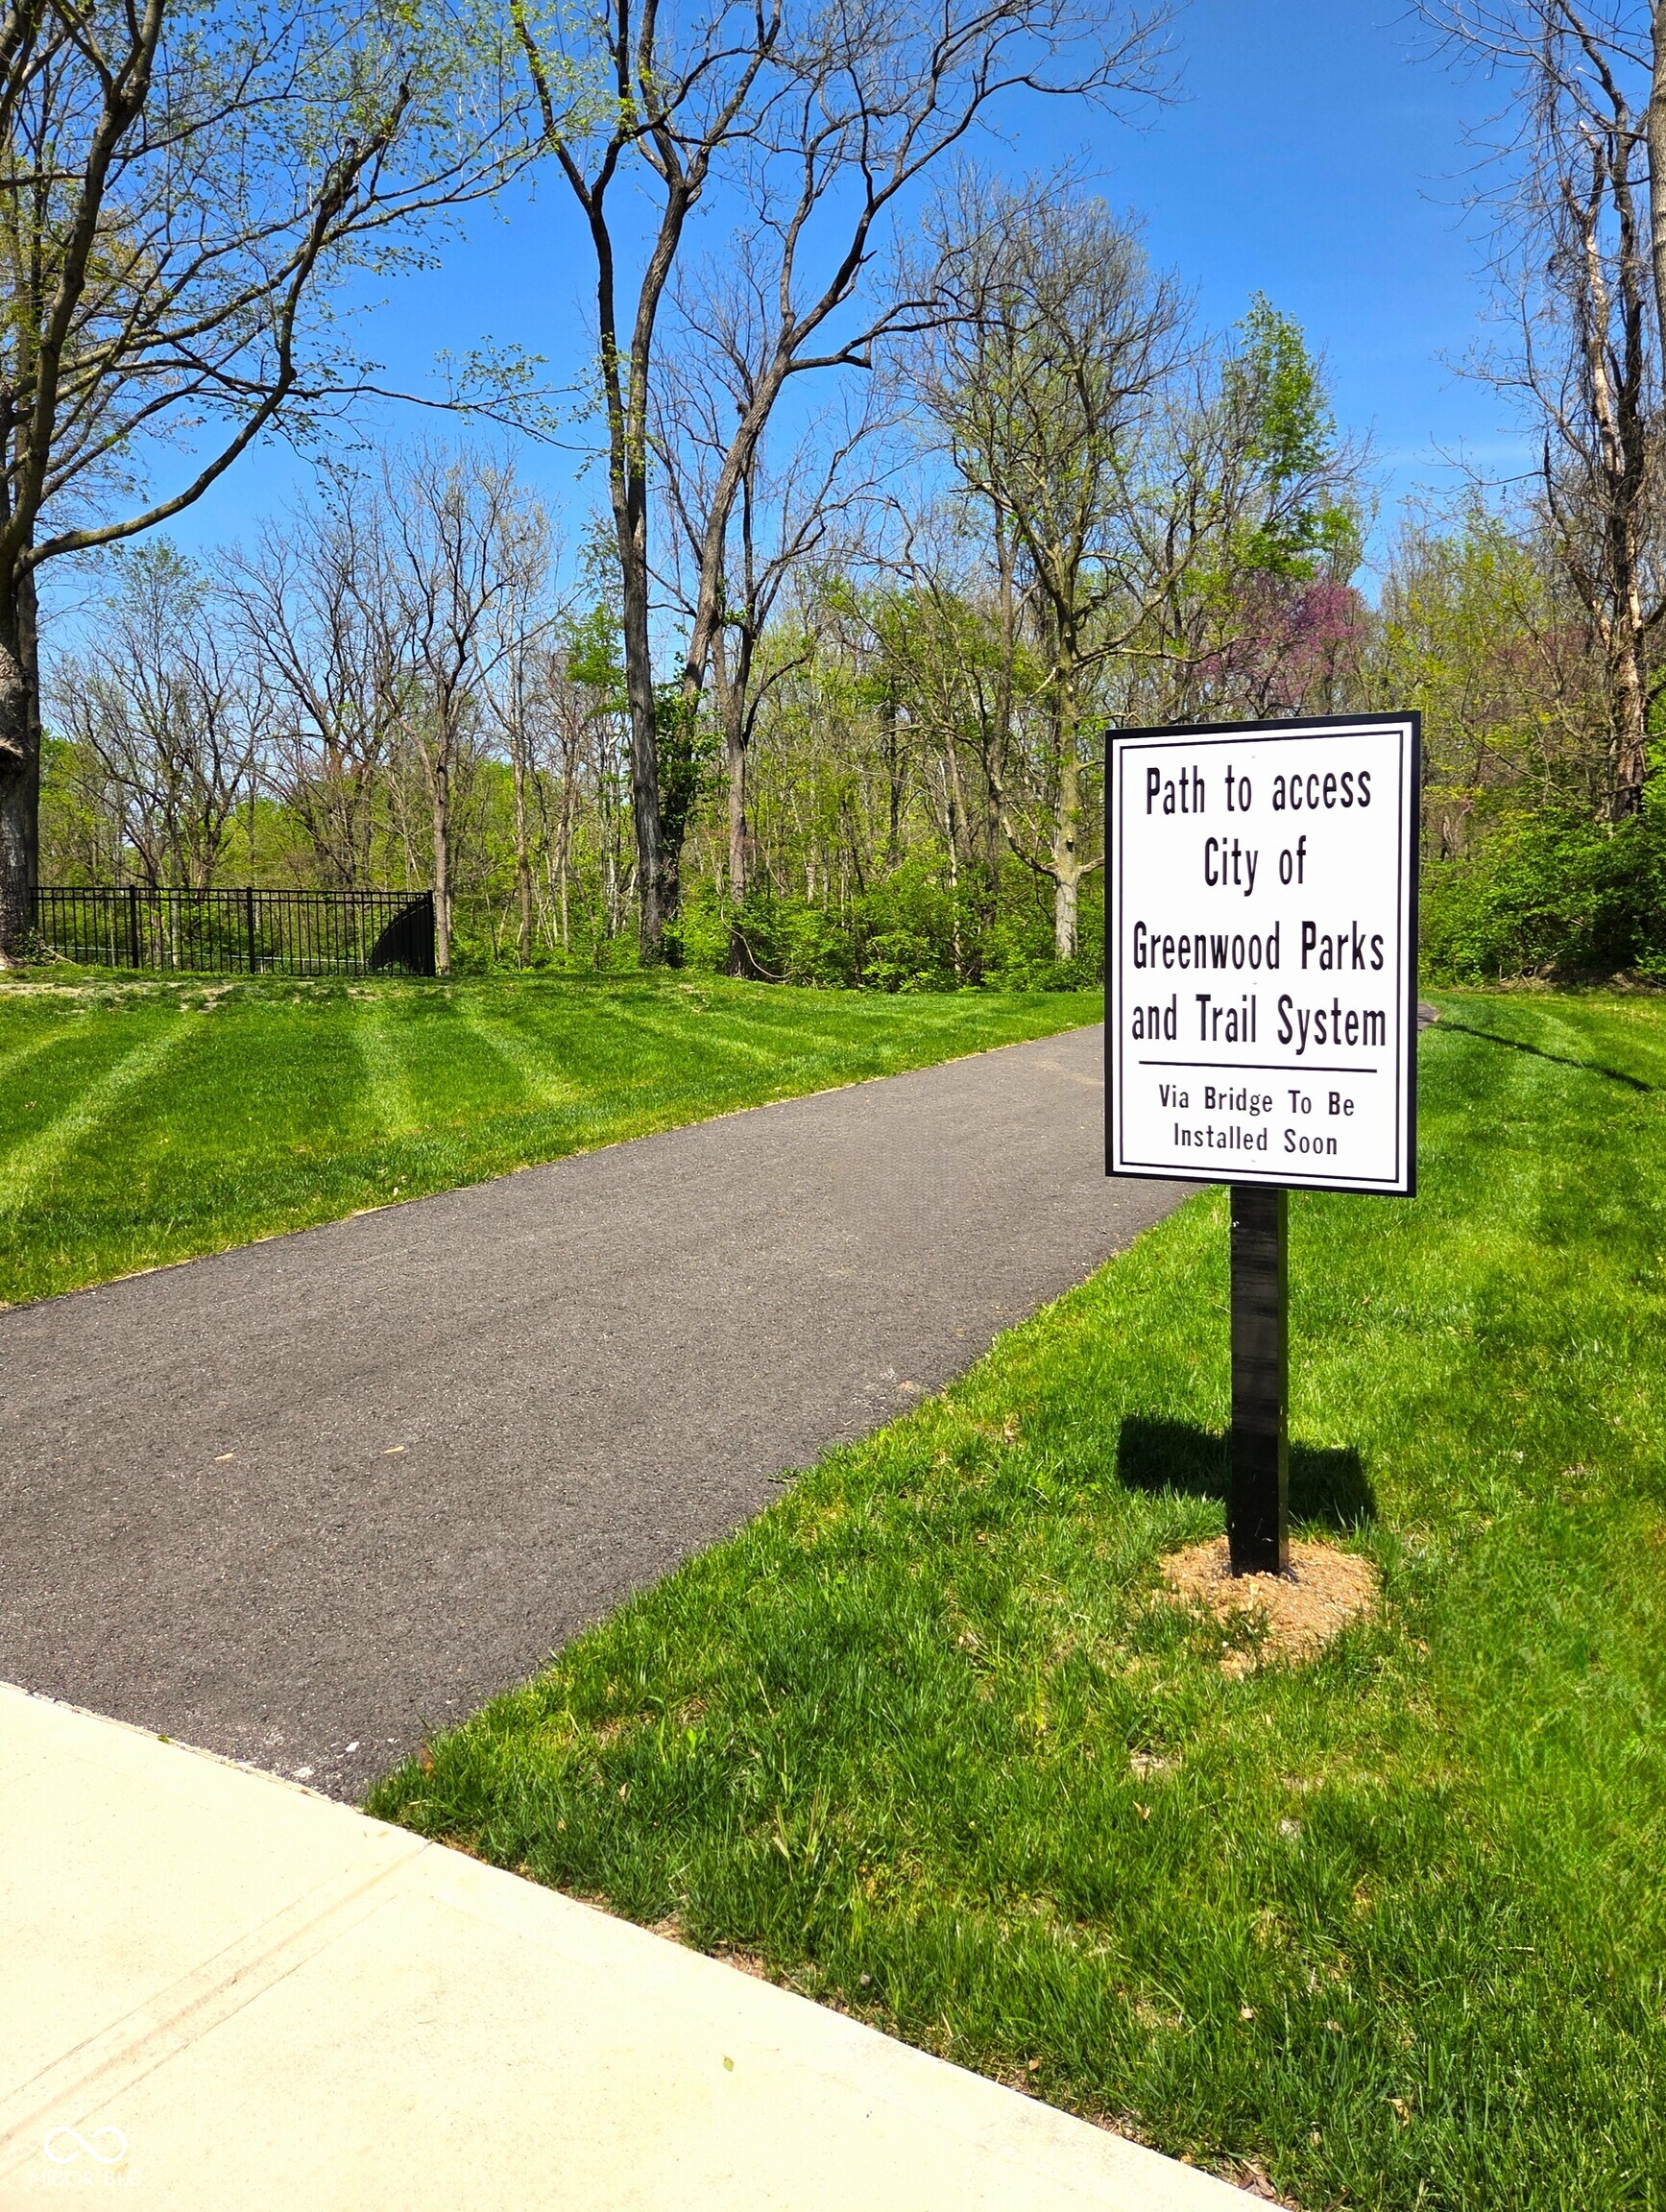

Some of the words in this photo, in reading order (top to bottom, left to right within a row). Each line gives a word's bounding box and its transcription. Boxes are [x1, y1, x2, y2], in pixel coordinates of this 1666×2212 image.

[1147, 764, 1205, 816] Path
[1224, 764, 1252, 812] to
[1271, 770, 1371, 811] access
[1204, 836, 1259, 898] City
[1279, 834, 1307, 885] of
[1133, 920, 1280, 971] Greenwood
[1301, 920, 1384, 972] Parks
[1131, 993, 1177, 1041] and
[1195, 994, 1257, 1044] Trail
[1277, 994, 1386, 1056] System
[1158, 1084, 1189, 1109] Via
[1204, 1086, 1273, 1117] Bridge
[1287, 1089, 1312, 1115] To
[1328, 1091, 1355, 1117] Be
[1174, 1122, 1268, 1151] Installed
[1284, 1128, 1338, 1155] Soon
